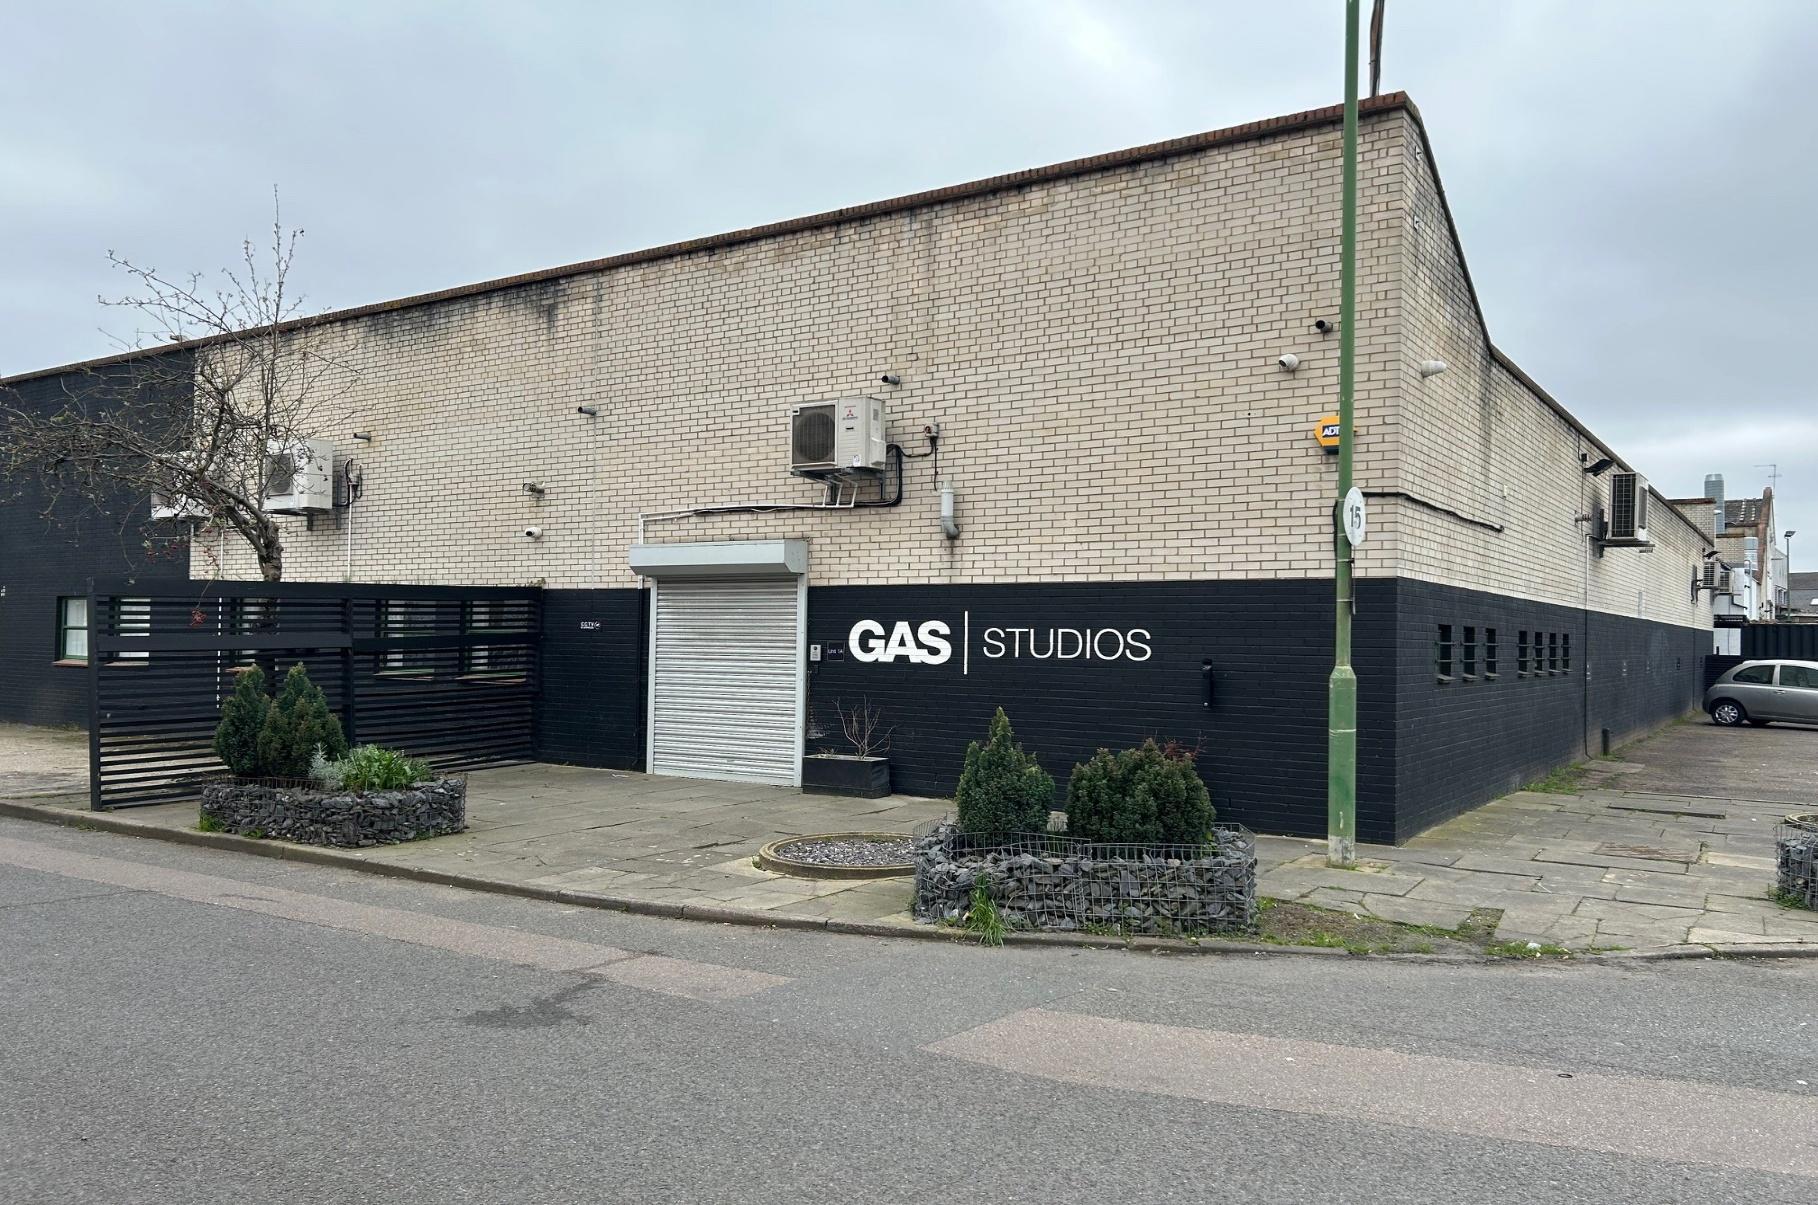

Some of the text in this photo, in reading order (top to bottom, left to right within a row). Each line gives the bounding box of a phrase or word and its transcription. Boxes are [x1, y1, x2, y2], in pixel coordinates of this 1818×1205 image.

[1322, 426, 1340, 436] ADT
[1350, 505, 1361, 529] 15
[849, 619, 1151, 665] GAS STUDIOS
